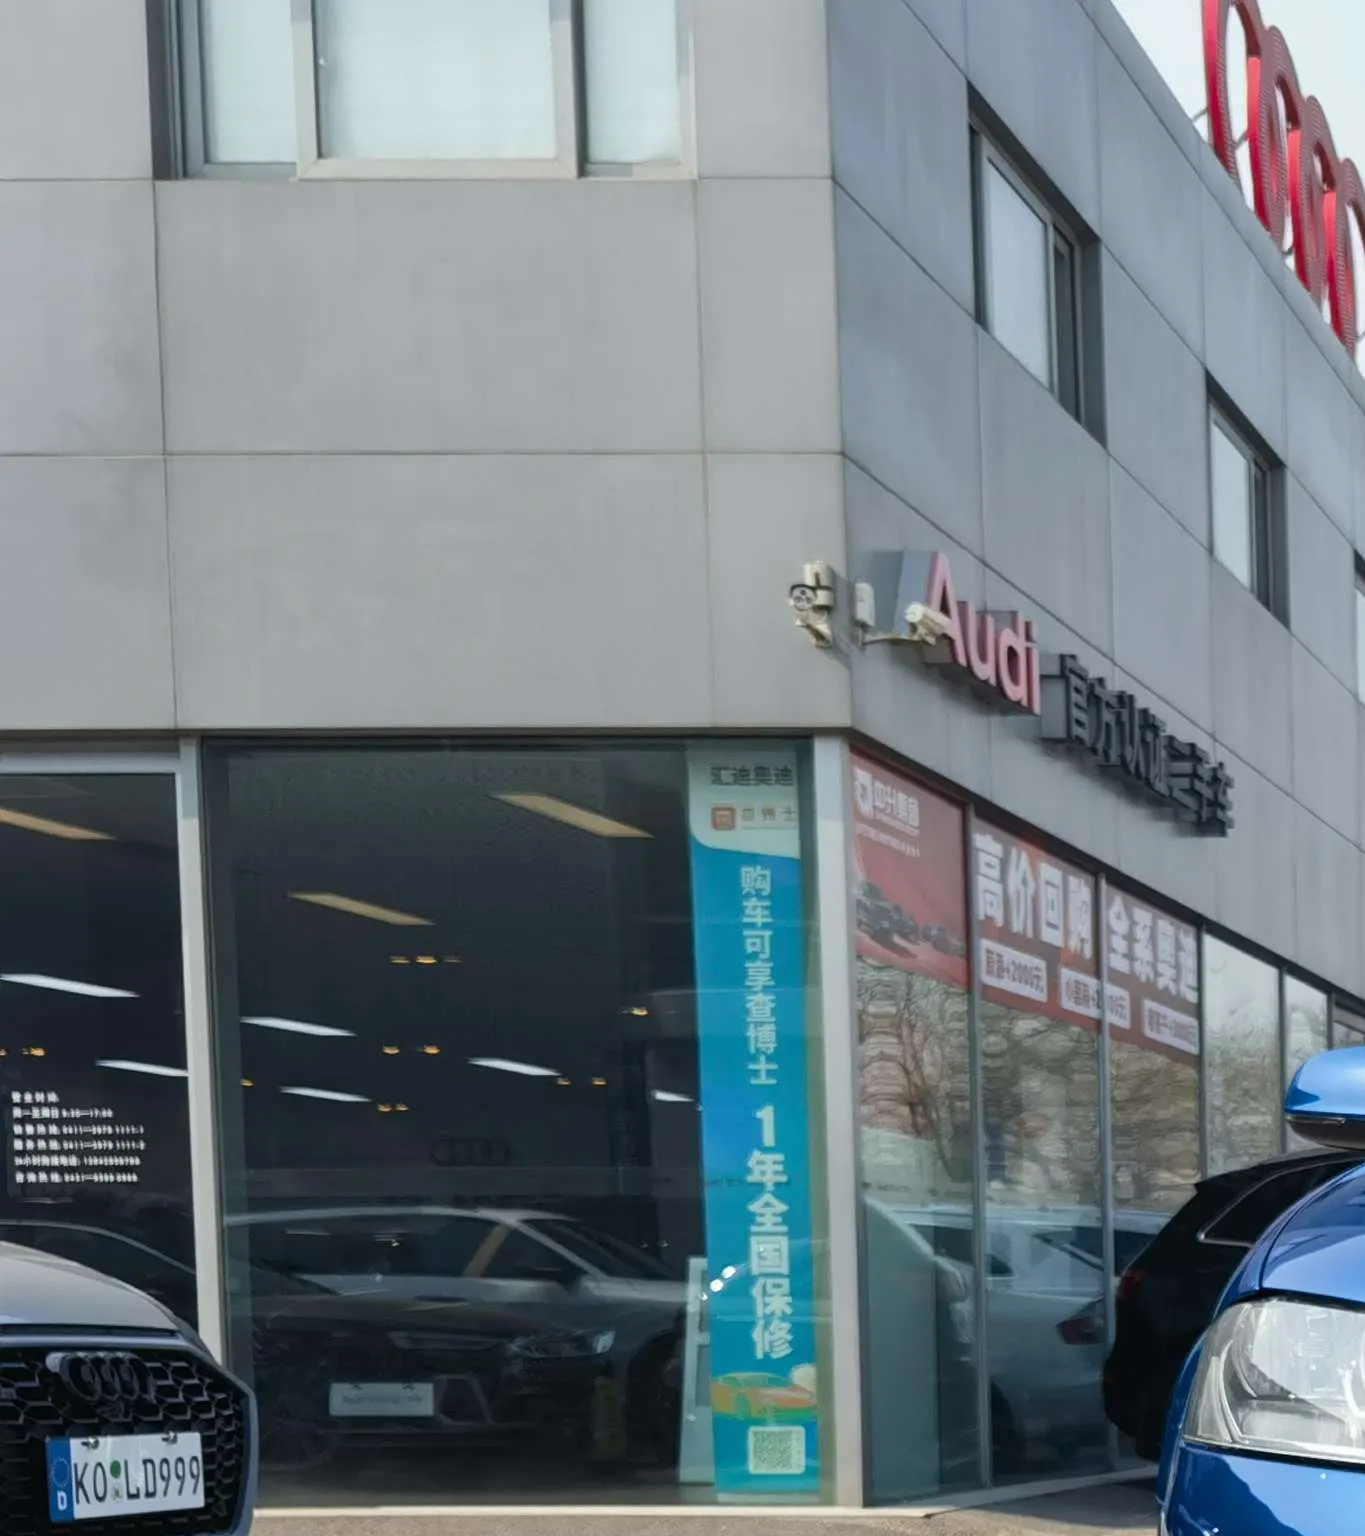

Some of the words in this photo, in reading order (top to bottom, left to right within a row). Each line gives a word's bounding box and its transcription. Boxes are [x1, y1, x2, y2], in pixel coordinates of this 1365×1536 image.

[925, 551, 1041, 716] Audi
[1058, 653, 1235, 836] 官方认证二手车
[740, 865, 778, 1085] 购车可享查博士
[974, 832, 1093, 960] 高价回购
[747, 1105, 793, 1360] 1年全国保修
[57, 1490, 68, 1511] D
